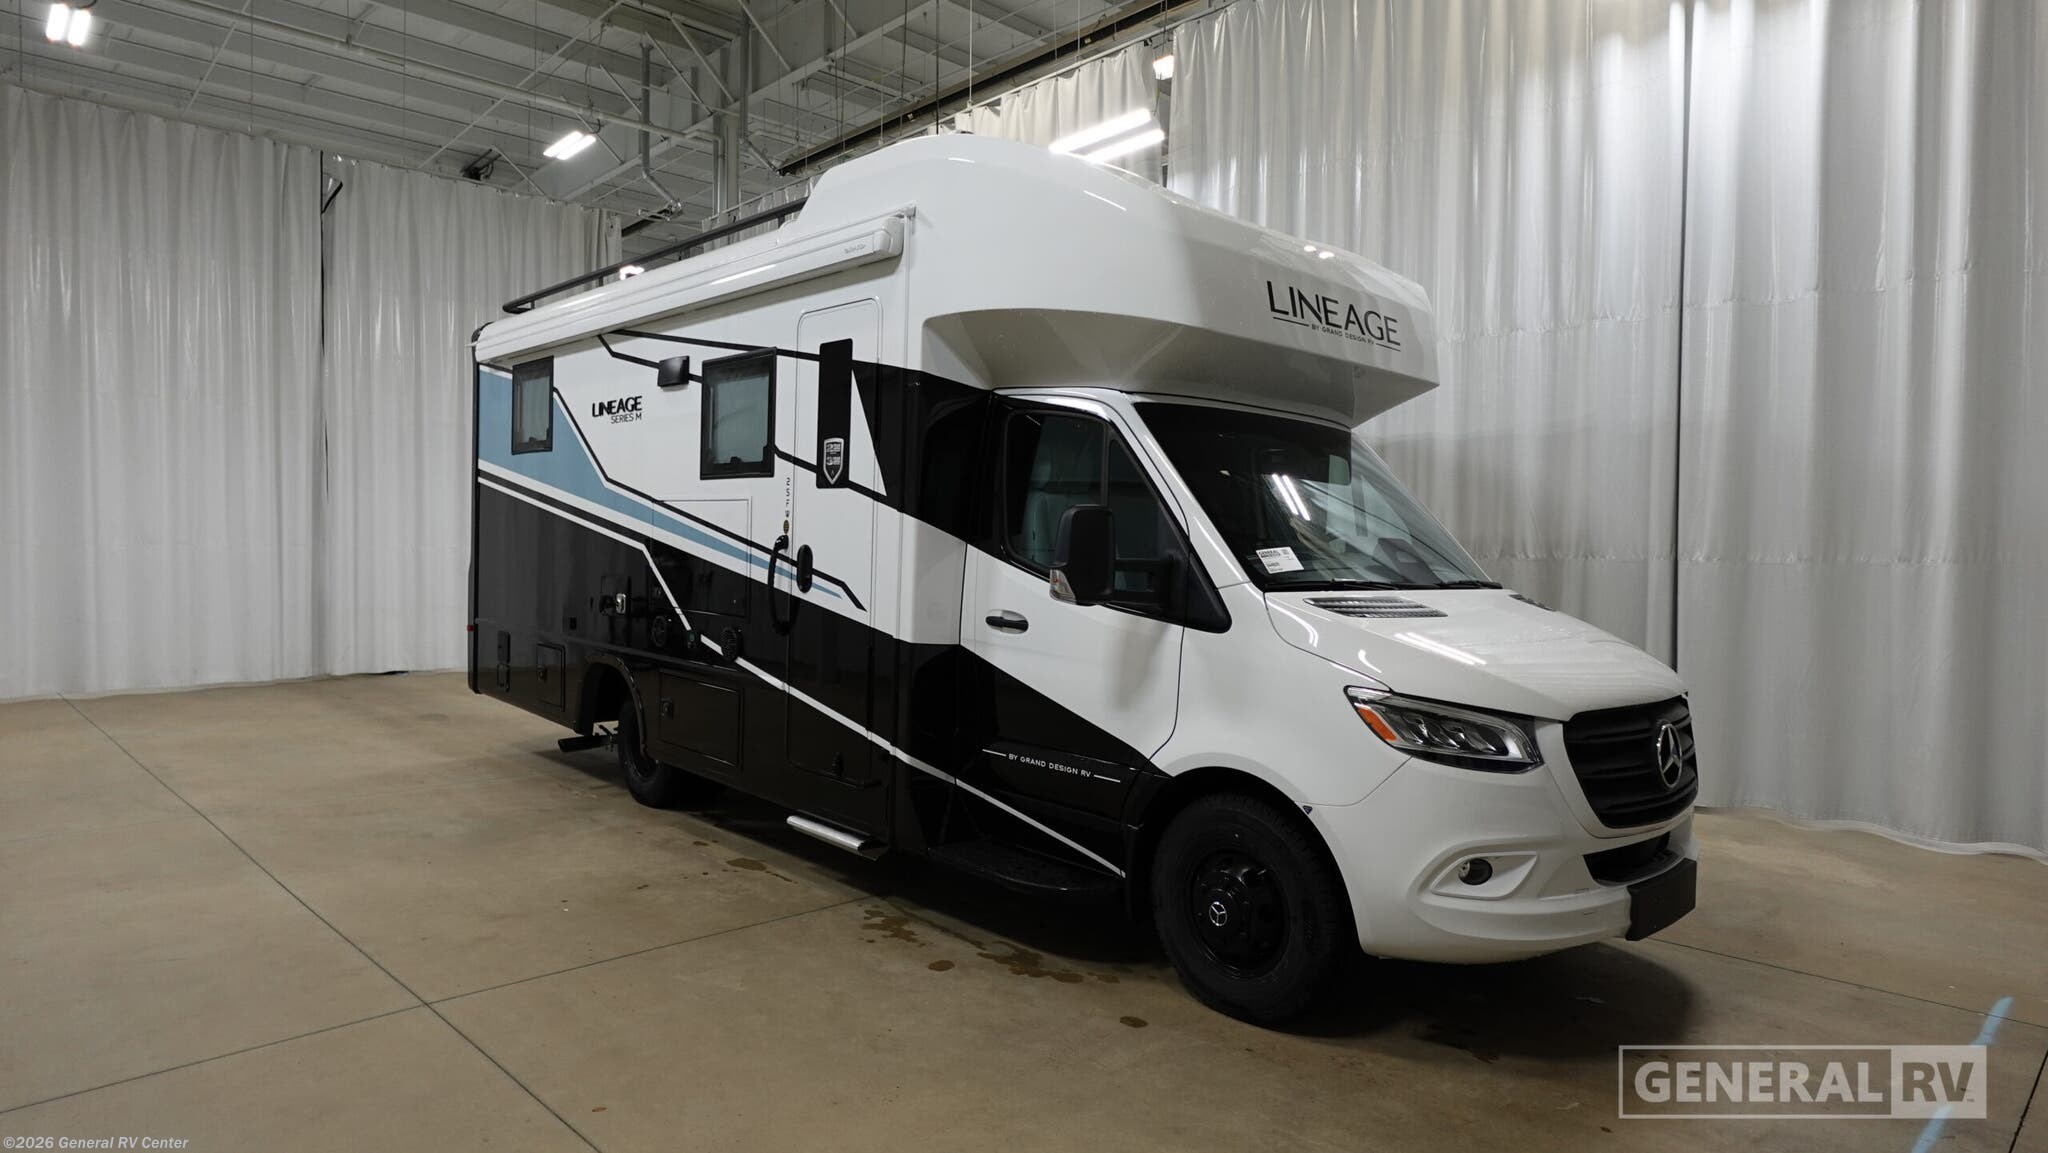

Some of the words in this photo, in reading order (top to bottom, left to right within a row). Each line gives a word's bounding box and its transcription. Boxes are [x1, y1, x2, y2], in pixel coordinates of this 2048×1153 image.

[1267, 280, 1401, 346] LINEAGE
[1322, 327, 1342, 337] GRAND
[592, 395, 643, 418] LINEAGE
[610, 412, 634, 424] SERIES
[635, 412, 642, 421] M
[1008, 753, 1018, 761] BY
[1020, 756, 1046, 768] GRAND
[1048, 762, 1079, 775] DESIGN
[1080, 769, 1092, 778] RV
